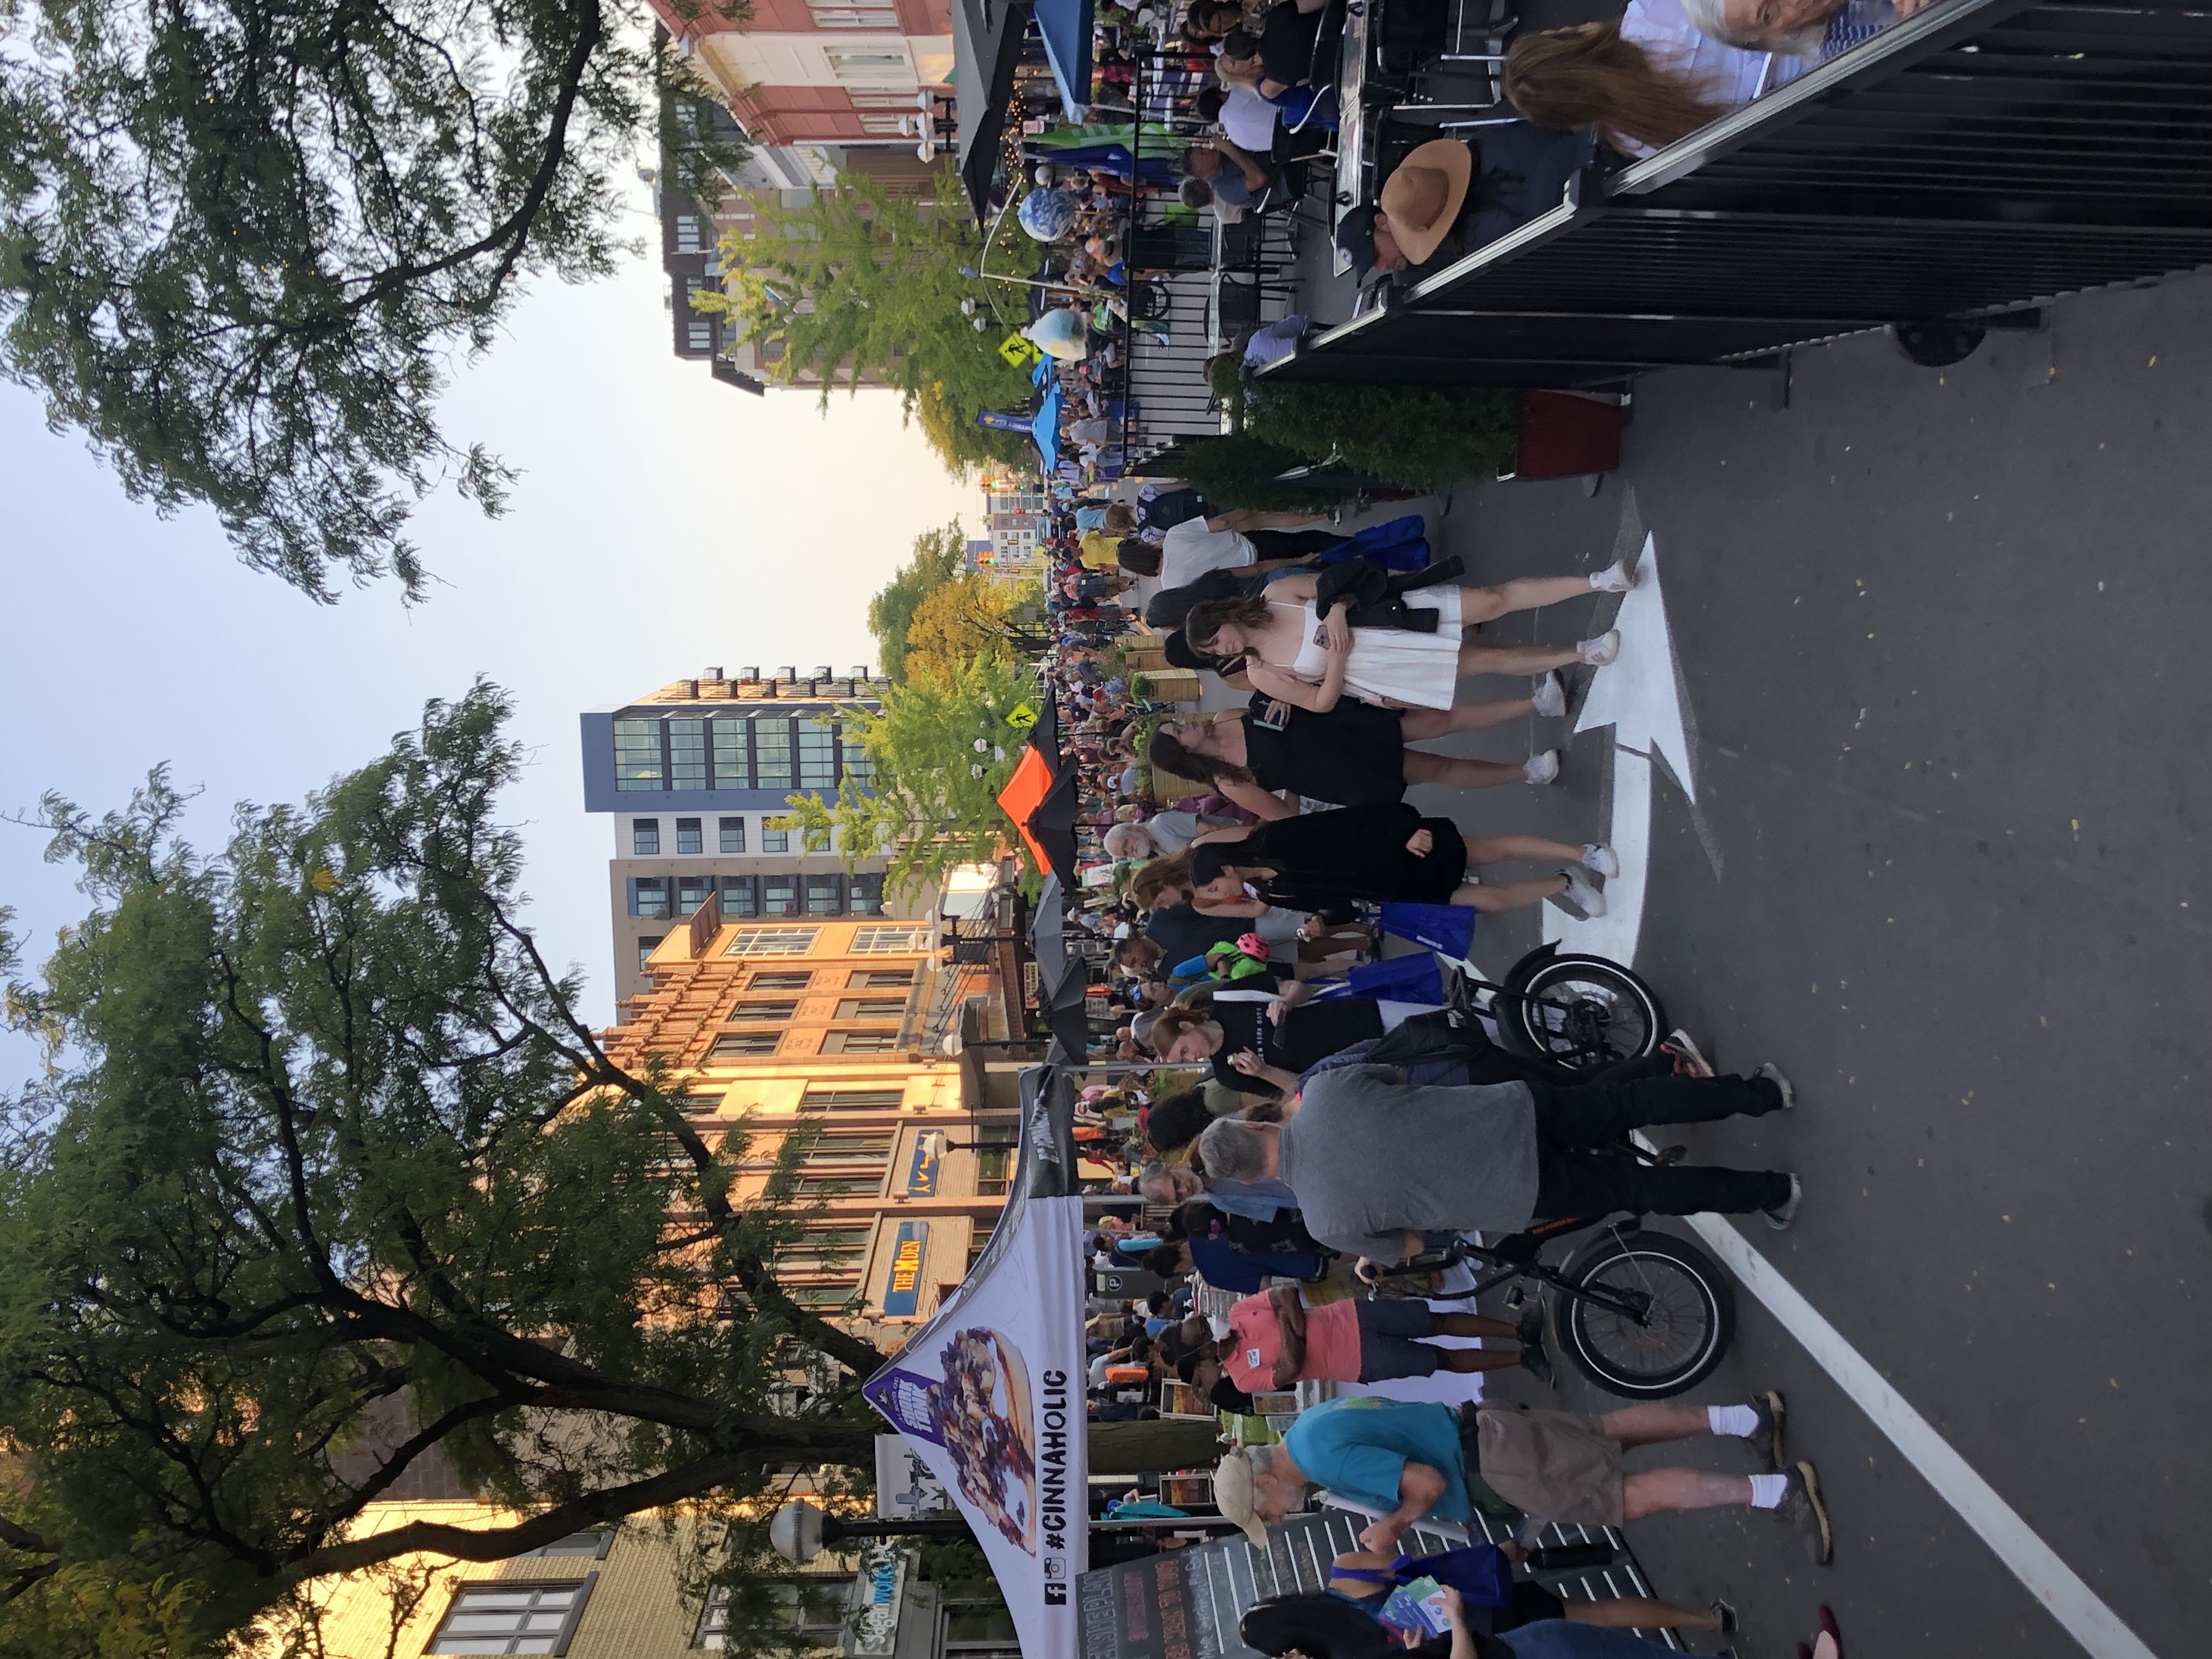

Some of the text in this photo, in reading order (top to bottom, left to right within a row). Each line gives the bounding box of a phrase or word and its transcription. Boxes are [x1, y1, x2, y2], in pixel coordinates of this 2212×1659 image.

[892, 1240, 921, 1293] THE M DEN
[1109, 1278, 1120, 1287] P
[891, 1391, 900, 1412] seen
[892, 1376, 899, 1389] on
[898, 1378, 918, 1429] SHARK
[912, 1384, 933, 1433] TANK
[1041, 1370, 1067, 1550] #CINNAHOLIC
[1082, 1570, 1114, 1612] PLAN
